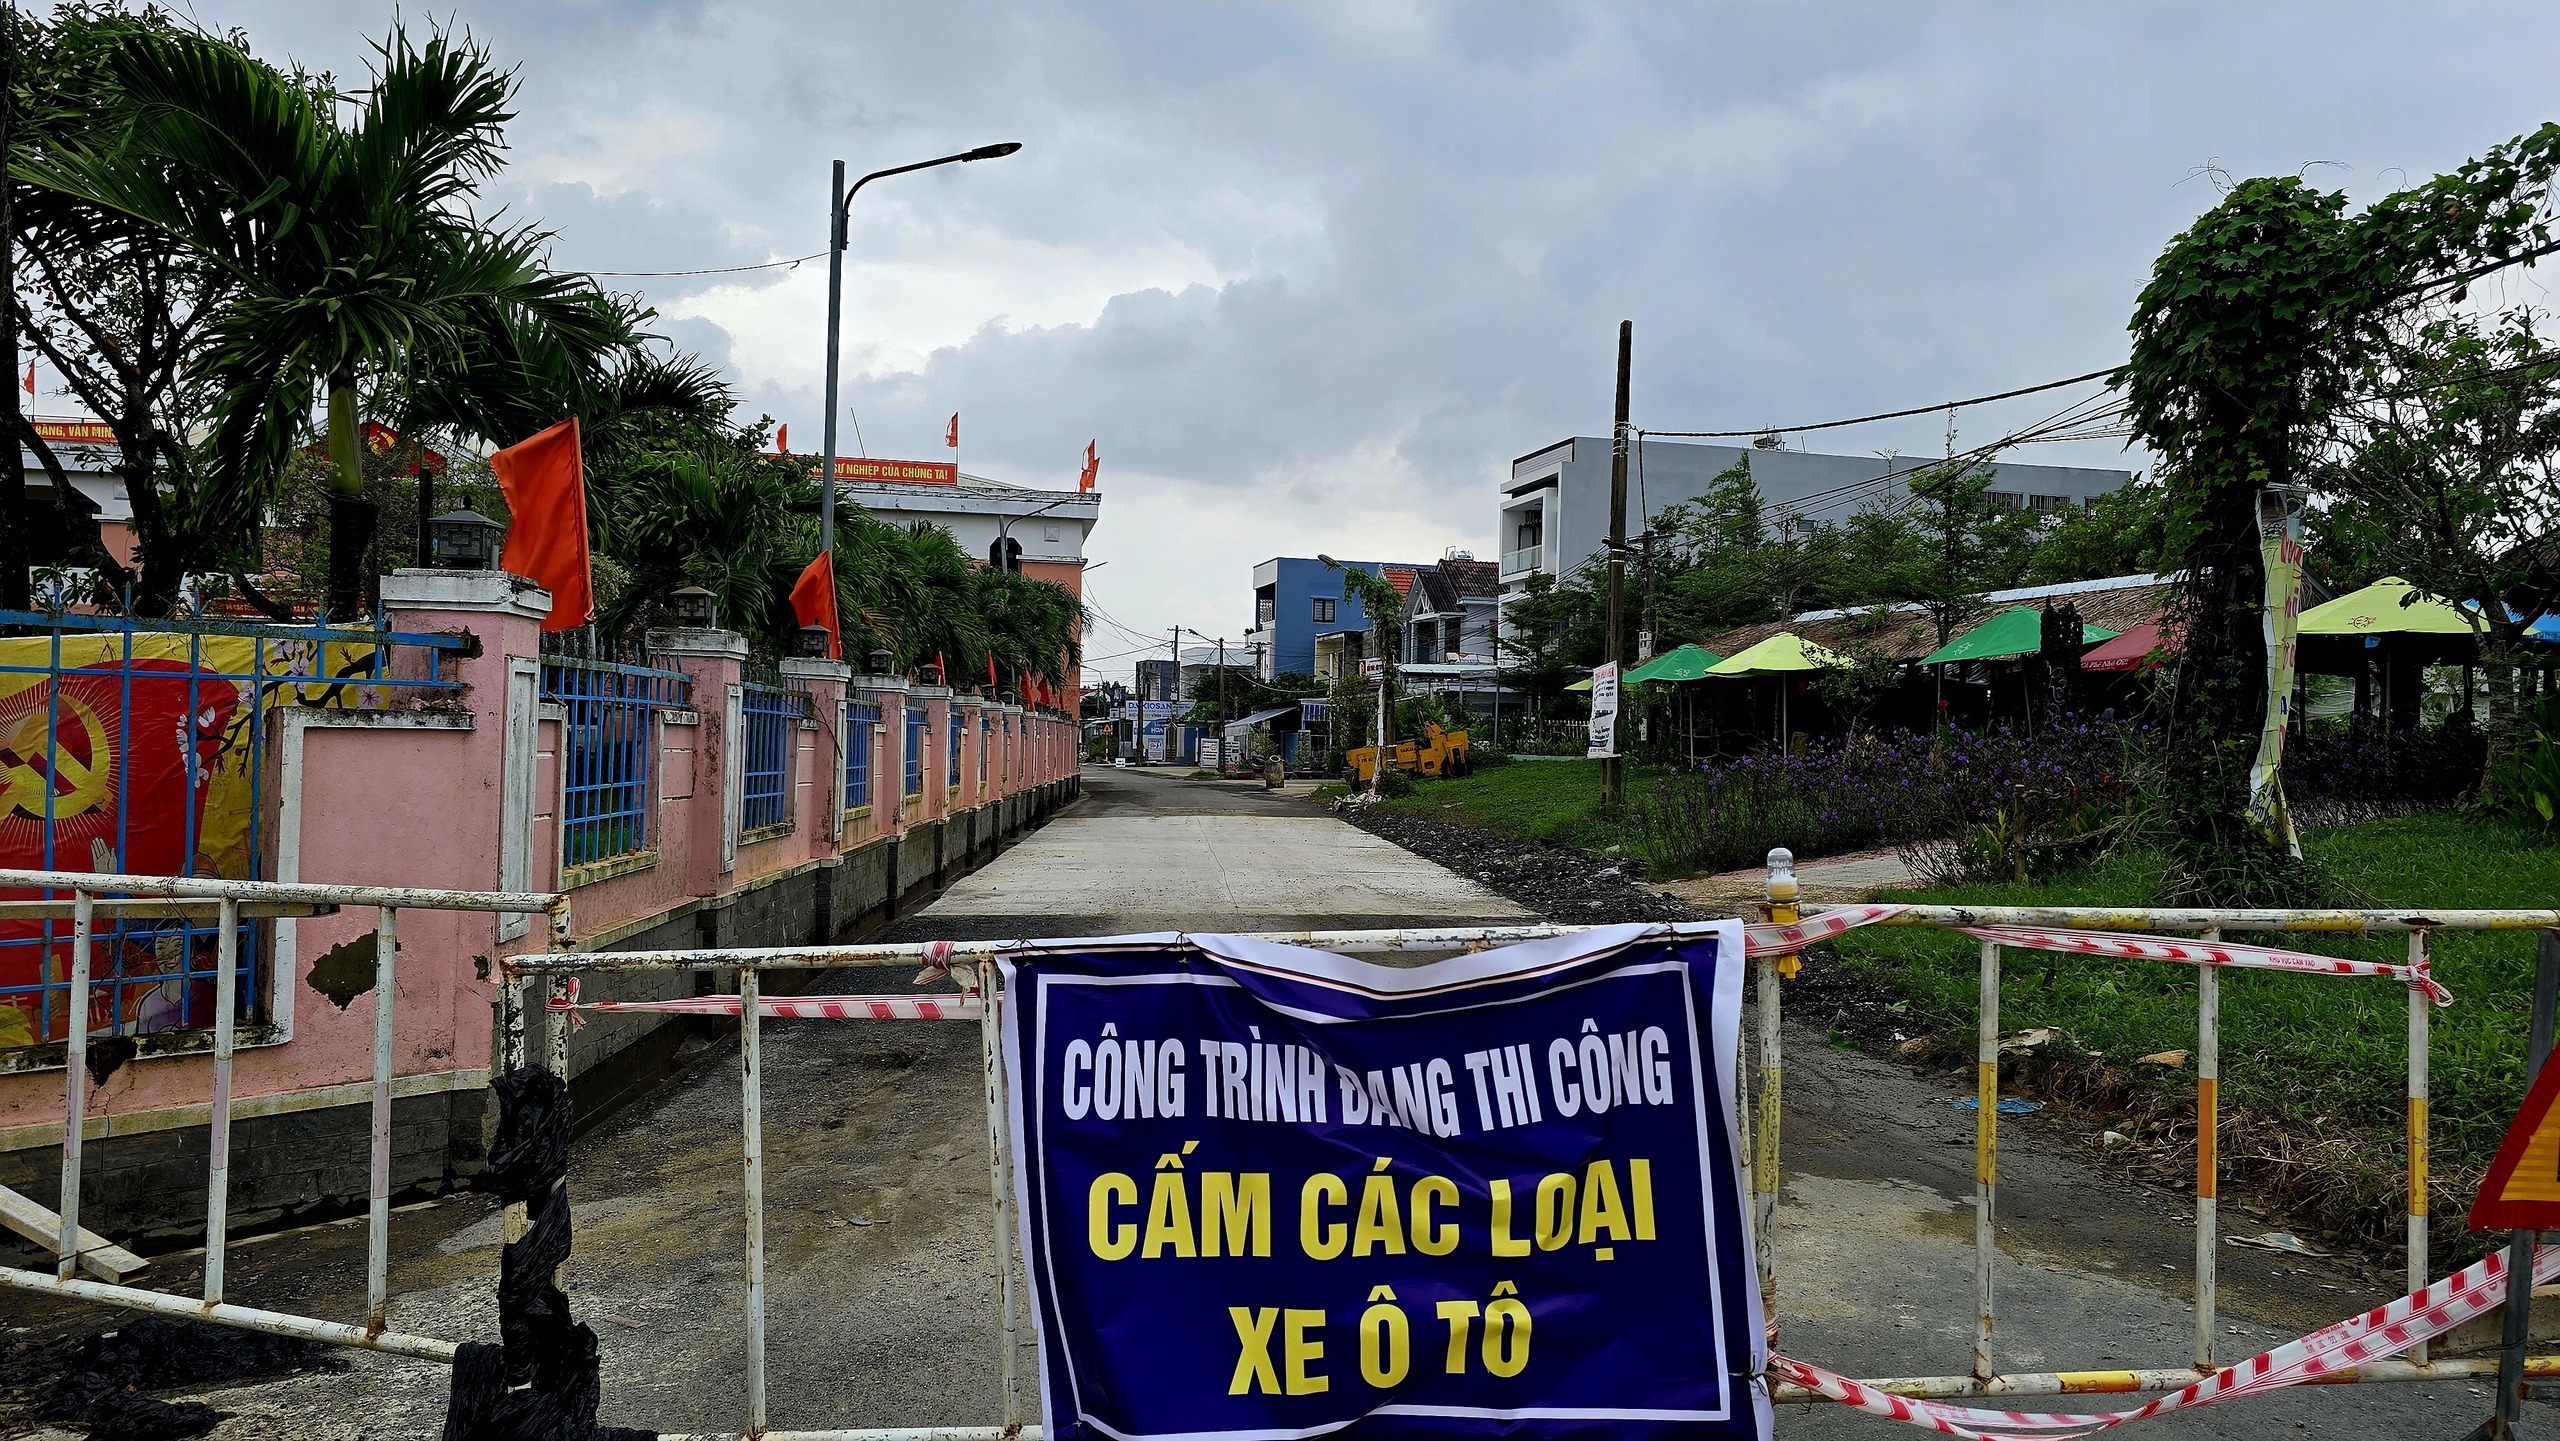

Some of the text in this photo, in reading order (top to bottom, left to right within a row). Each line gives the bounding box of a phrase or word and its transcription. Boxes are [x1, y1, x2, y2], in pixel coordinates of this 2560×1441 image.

[69, 425, 89, 437] VĂN
[92, 426, 115, 438] MIN
[847, 463, 879, 477] NGHIỆP
[882, 465, 900, 477] CỦA
[902, 466, 932, 479] CHÚNG
[935, 469, 948, 480] TA!
[1064, 1018, 1673, 1137] CÔNG TRÌNH ĐANG THI CÔNG
[1088, 1140, 1656, 1261] CẤM CÁC LOẠI
[1228, 1279, 1532, 1395] XE Ô TÔ
